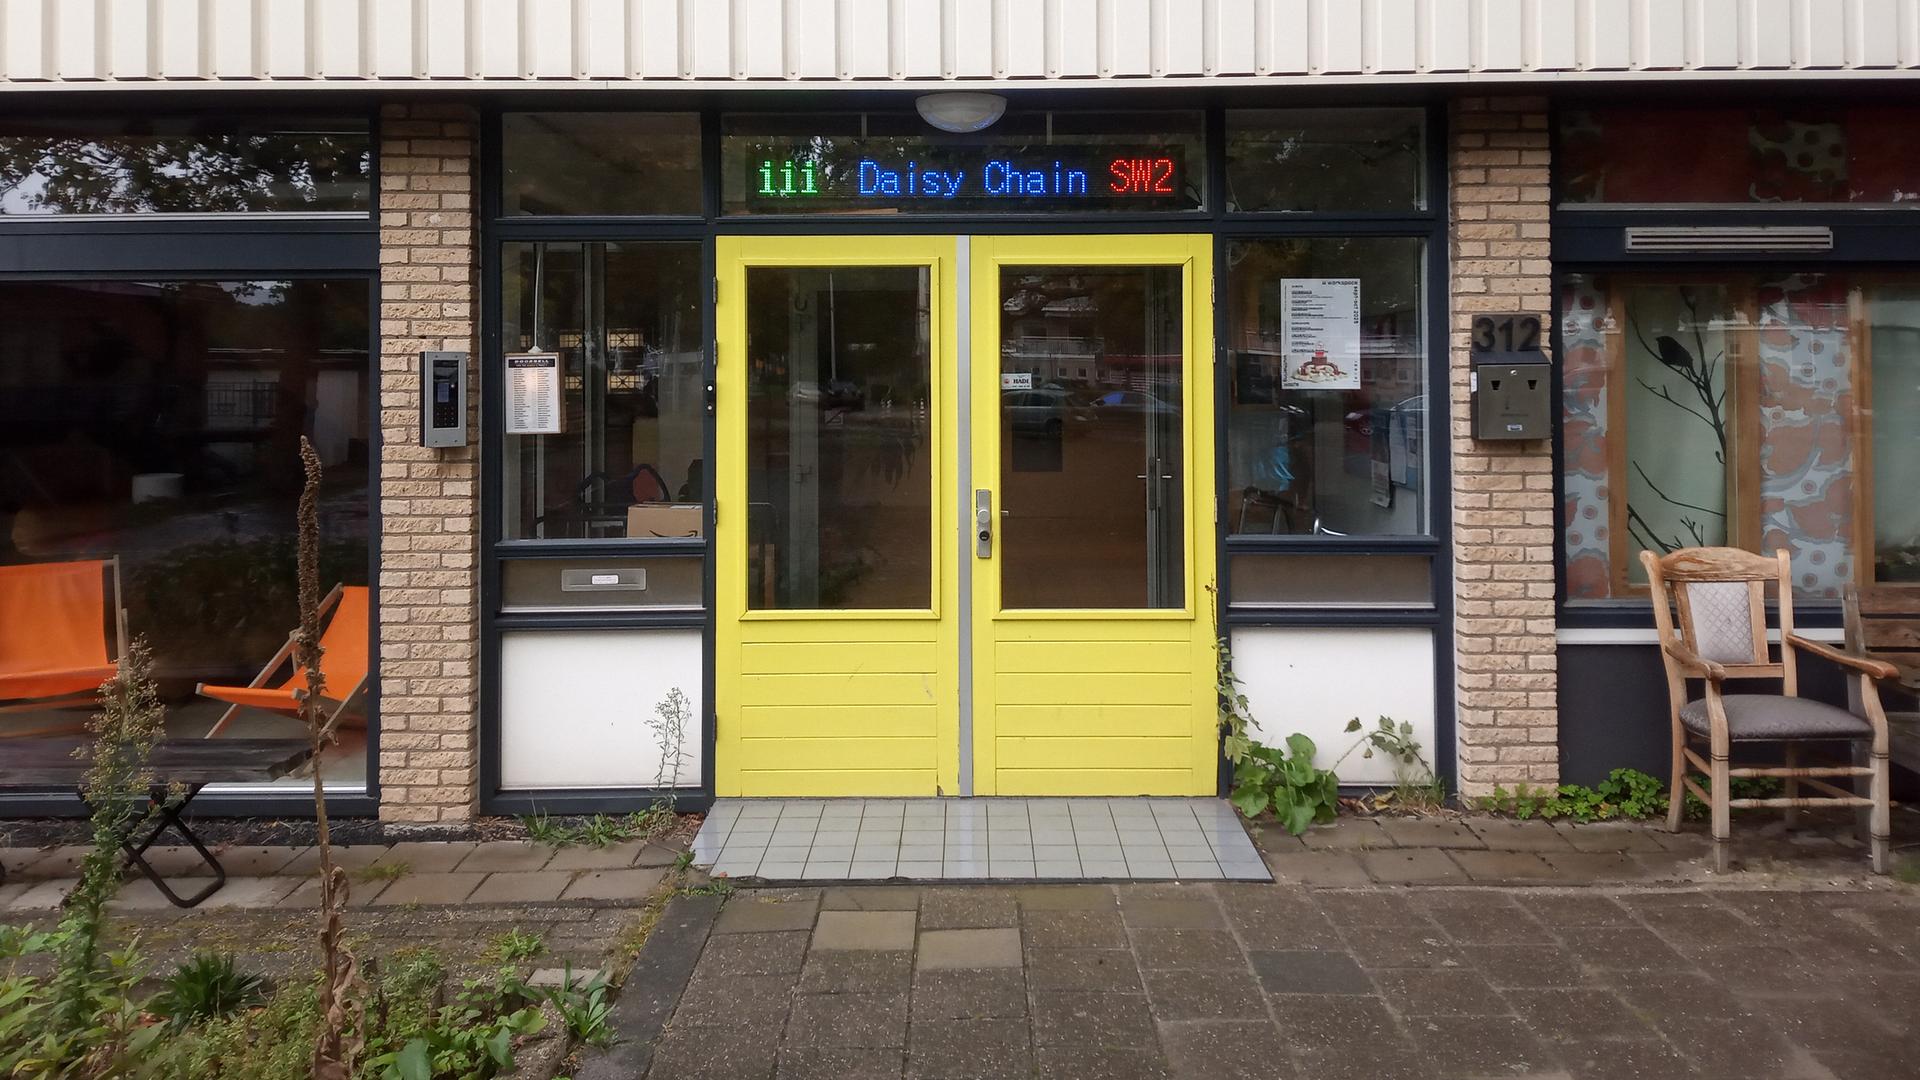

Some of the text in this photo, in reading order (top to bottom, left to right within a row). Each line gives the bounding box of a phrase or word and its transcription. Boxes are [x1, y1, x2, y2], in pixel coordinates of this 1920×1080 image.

[758, 159, 1173, 197] iii Daisy Chain SW2
[1473, 316, 1542, 352] 312
